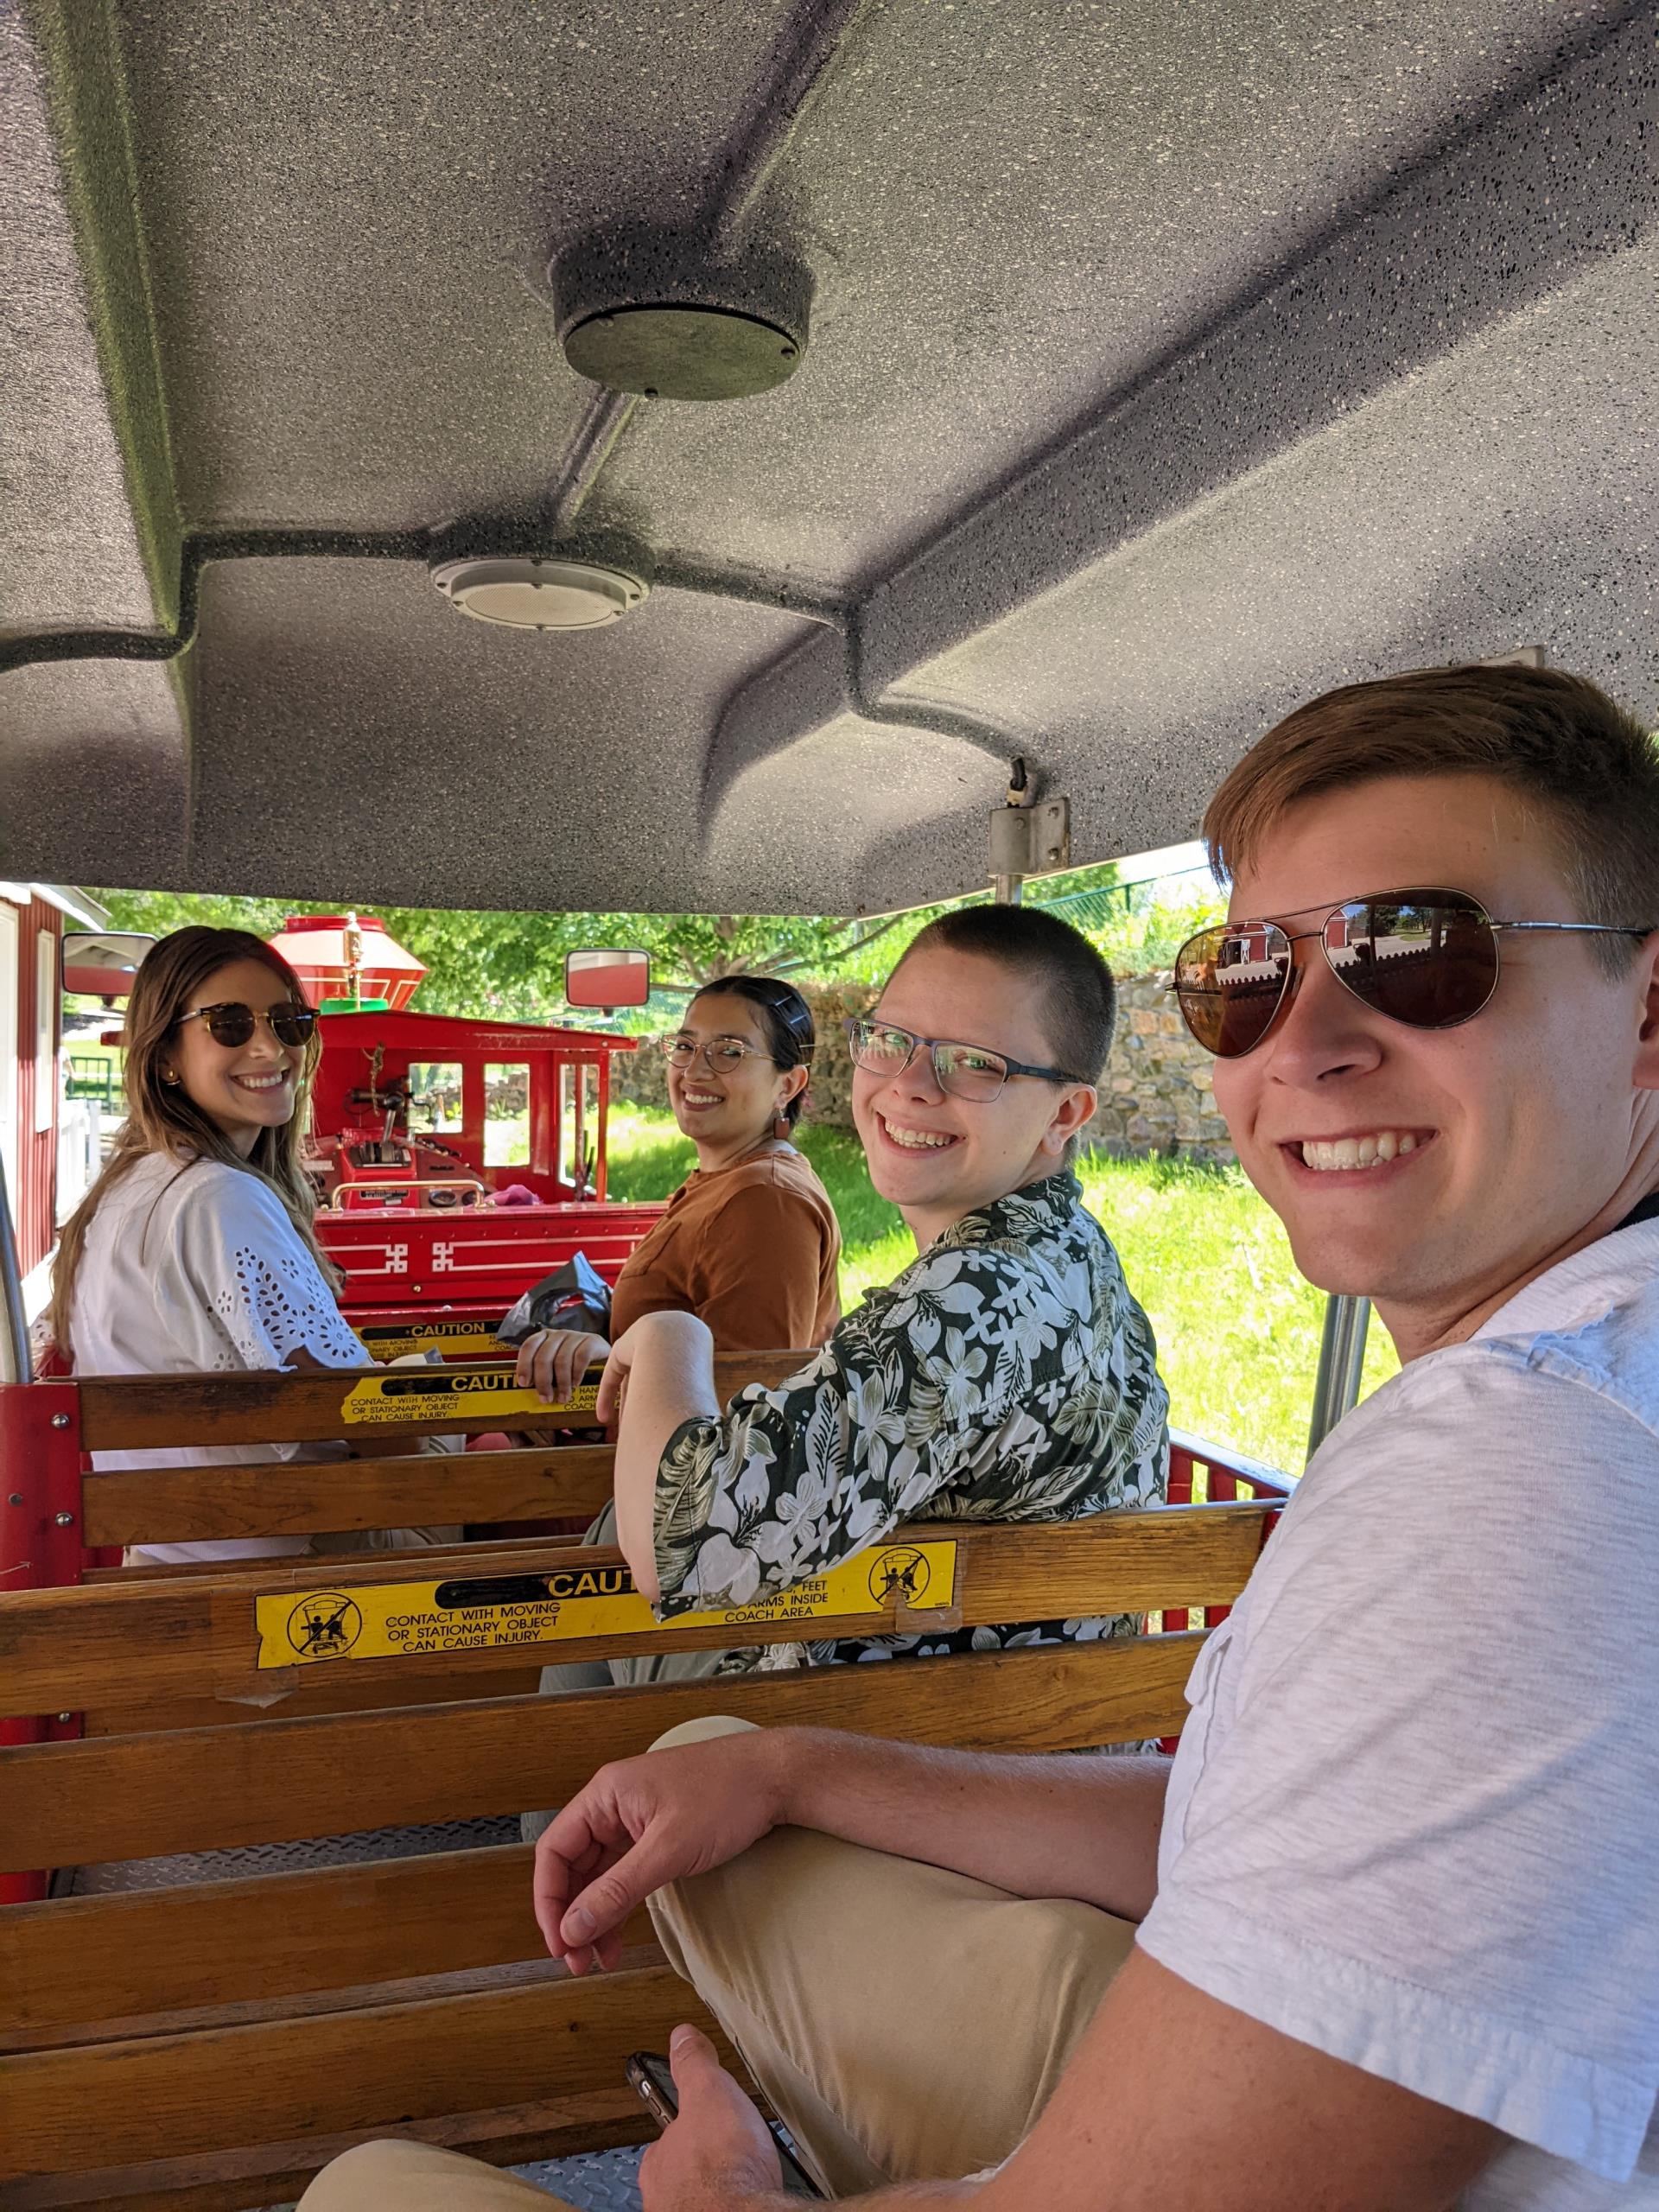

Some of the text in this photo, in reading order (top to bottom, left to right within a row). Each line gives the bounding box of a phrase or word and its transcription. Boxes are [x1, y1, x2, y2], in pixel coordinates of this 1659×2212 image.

[411, 1322, 485, 1337] CAUTION
[451, 1374, 518, 1391] CAUTI
[351, 1394, 460, 1407] CONTACT WITH MOVING
[370, 1404, 422, 1414] STATIONARY
[426, 1402, 458, 1411] OBJECT
[548, 1569, 639, 1598] CAUT
[802, 1580, 827, 1592] FEET
[791, 1592, 828, 1605] INSIDE
[385, 1602, 561, 1627] CONTACT WITH MOVING
[725, 1606, 814, 1623] COACH AREA
[388, 1616, 558, 1641] OR STATIONARY OBJECT
[403, 1630, 543, 1652] CAN CAUSE INJURY.
